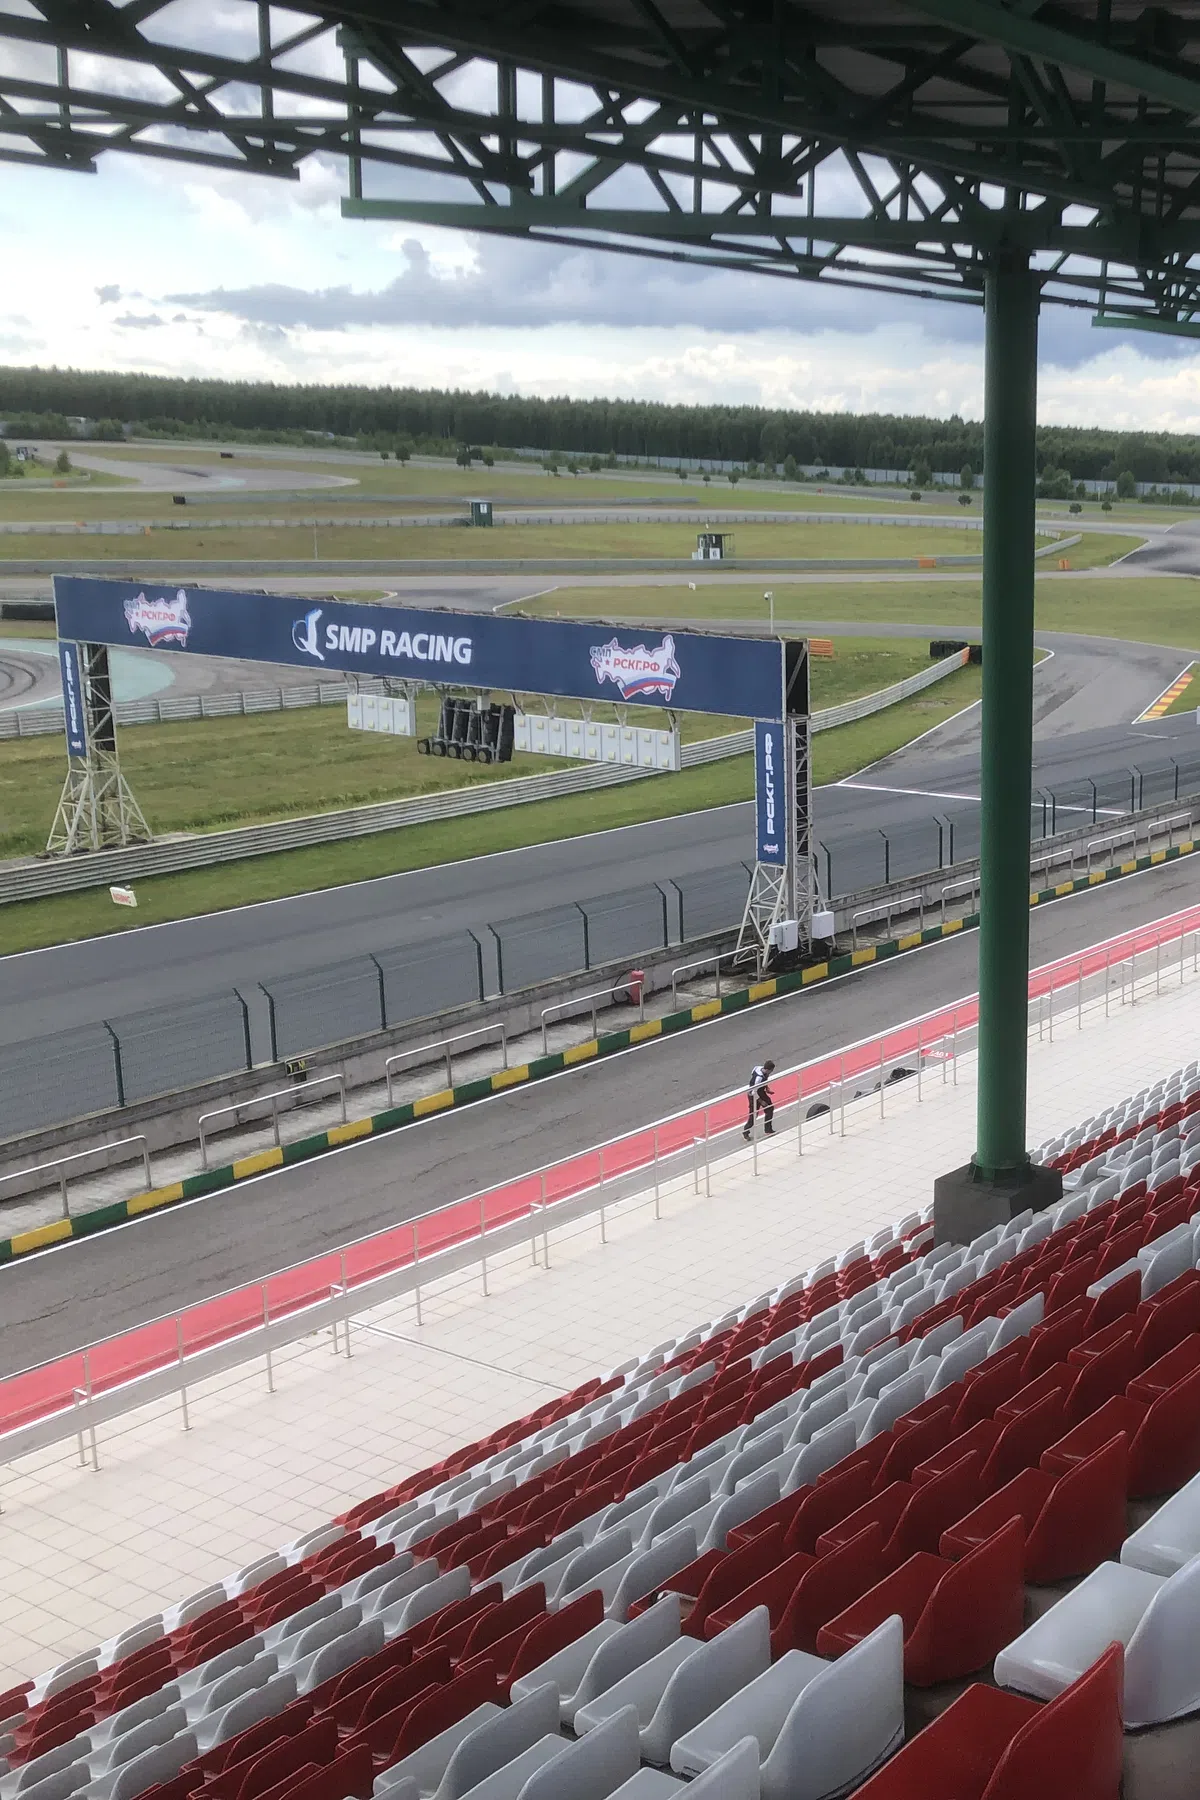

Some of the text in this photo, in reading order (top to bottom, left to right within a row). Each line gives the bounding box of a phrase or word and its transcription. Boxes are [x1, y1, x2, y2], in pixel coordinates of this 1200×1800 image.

[325, 624, 472, 664] SMP RACING
[613, 658, 660, 672] РСКГ.РФ
[765, 733, 775, 834] РСКГ.РФ
